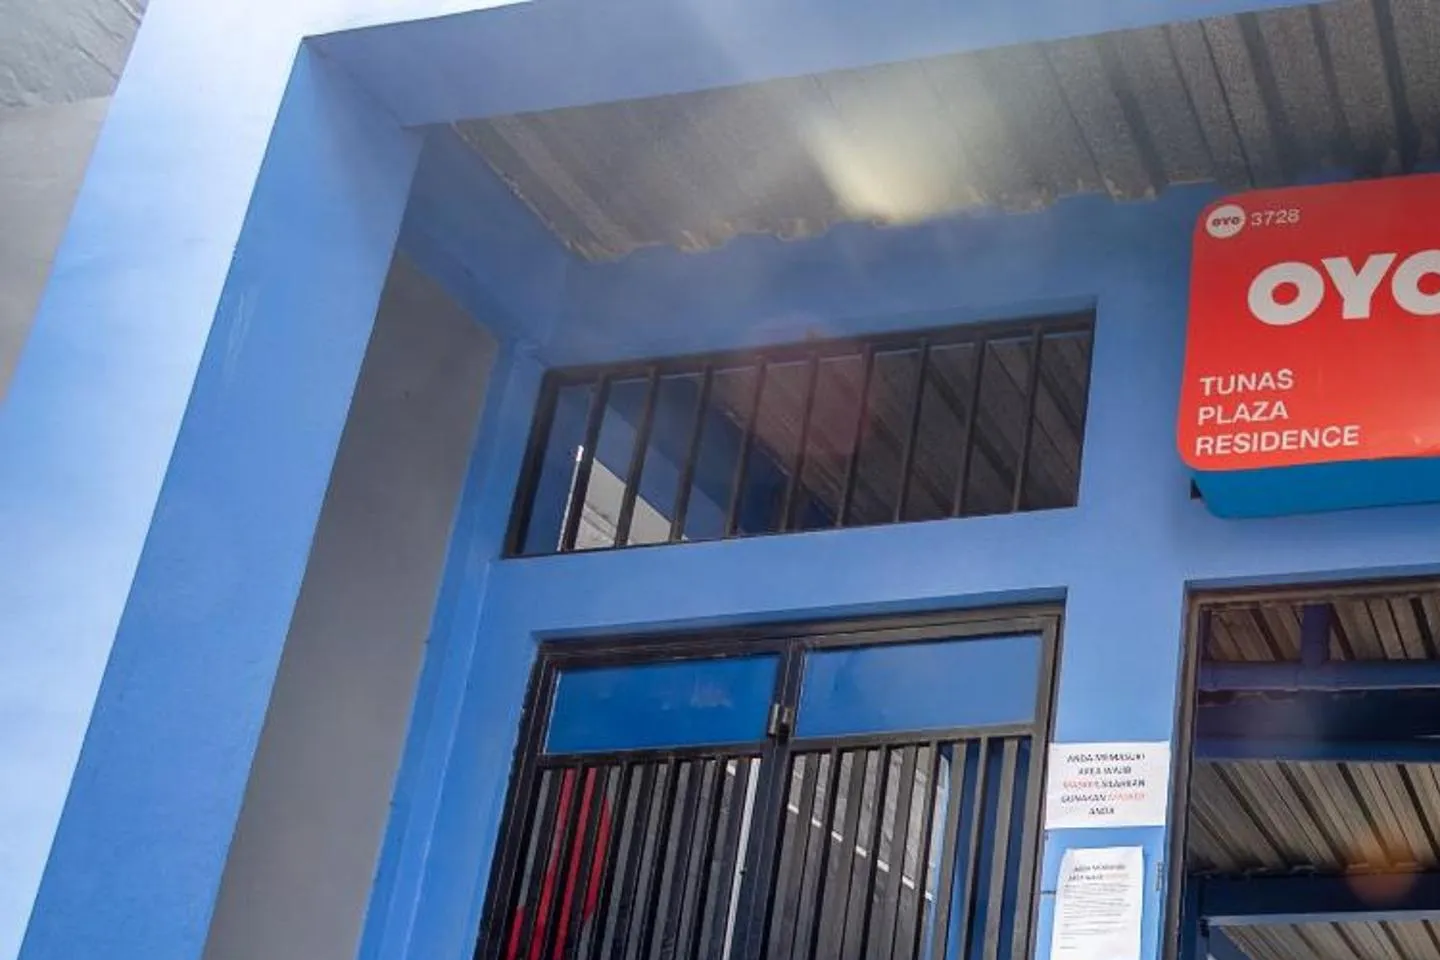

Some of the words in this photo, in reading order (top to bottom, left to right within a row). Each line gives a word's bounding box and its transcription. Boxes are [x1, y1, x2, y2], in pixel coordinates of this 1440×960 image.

[1251, 208, 1300, 226] 3728
[1200, 368, 1294, 396] TUNAS
[1198, 401, 1288, 425] PLAZA
[1195, 425, 1360, 456] RESIDENCE
